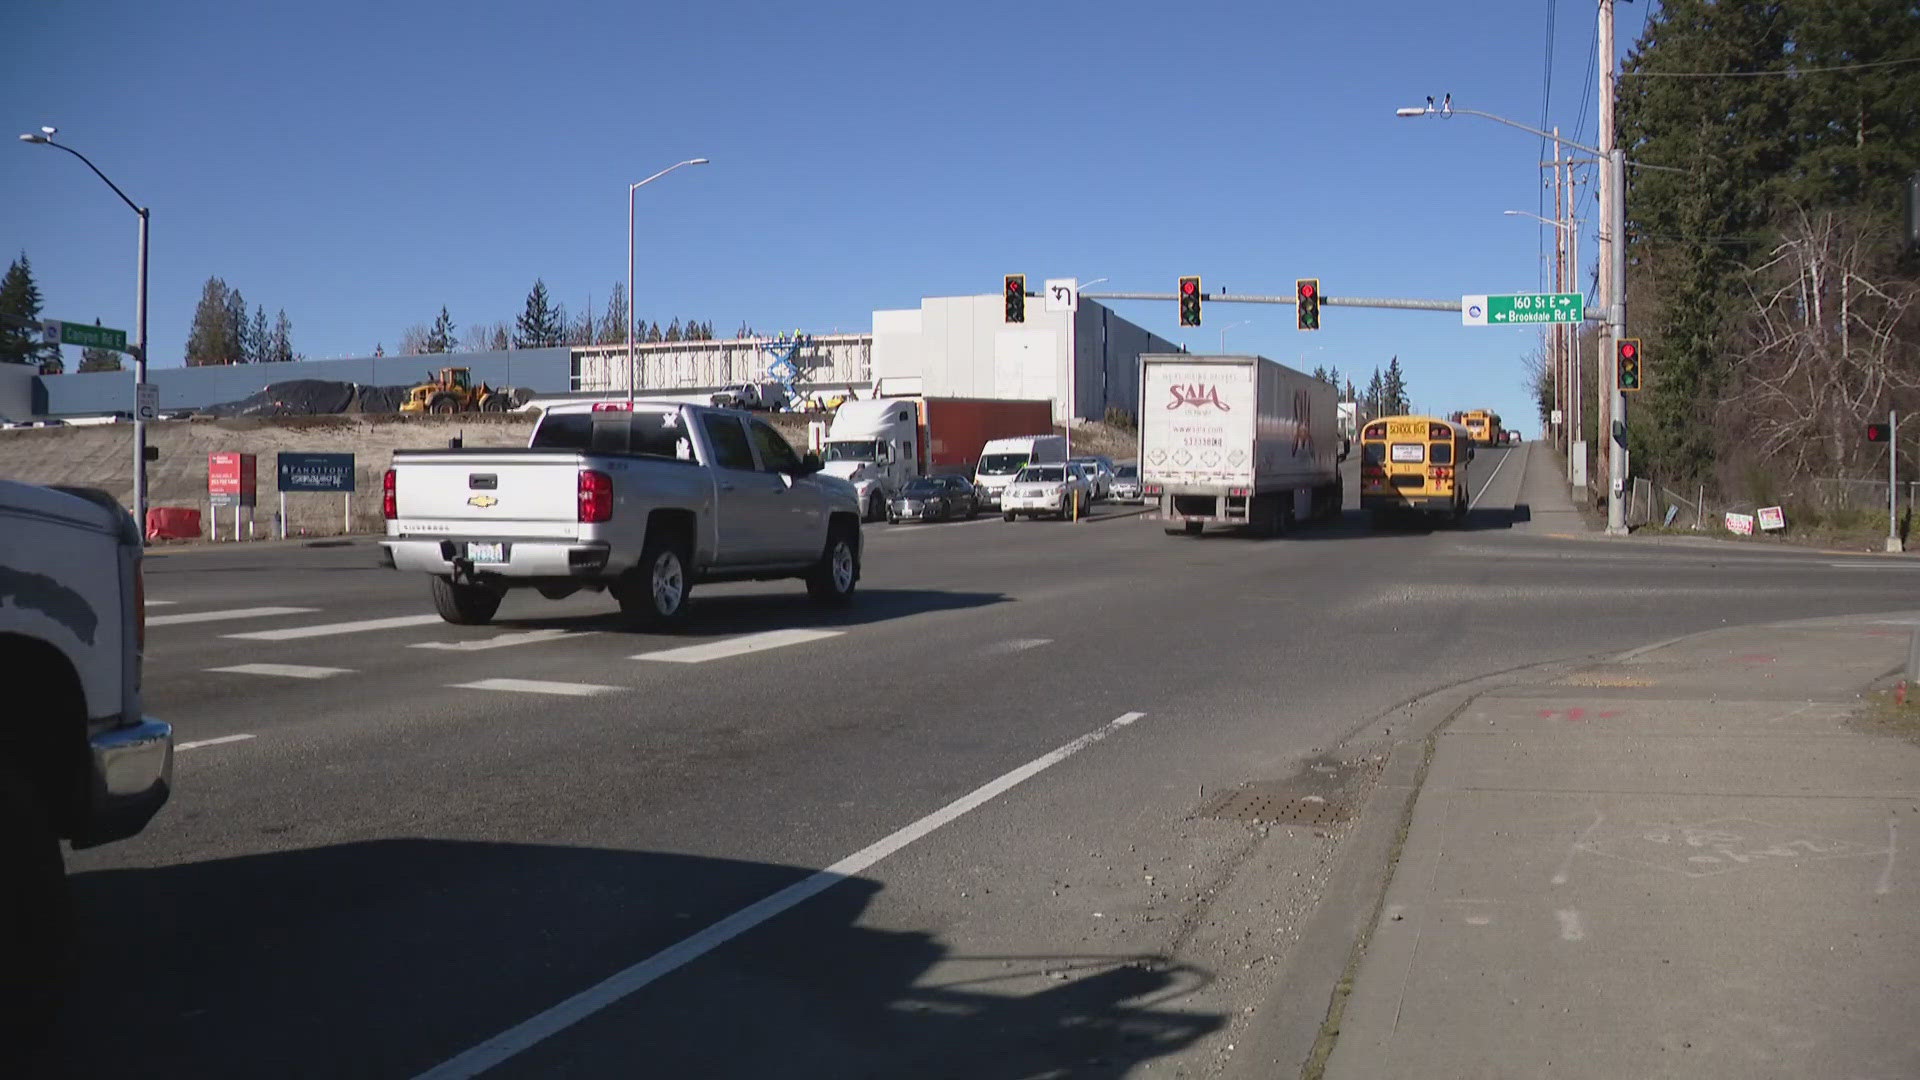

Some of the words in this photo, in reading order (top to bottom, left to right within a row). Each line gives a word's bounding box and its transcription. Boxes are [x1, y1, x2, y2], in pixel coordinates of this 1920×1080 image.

[1514, 297, 1531, 309] 160
[1535, 296, 1545, 309] St
[1549, 296, 1556, 308] E
[1508, 310, 1550, 322] Brookdale
[1554, 309, 1566, 321] Rd
[1570, 308, 1577, 320] E
[1166, 384, 1230, 411] SAIA
[1390, 422, 1411, 434] SCHOOL
[1413, 422, 1426, 434] BUS
